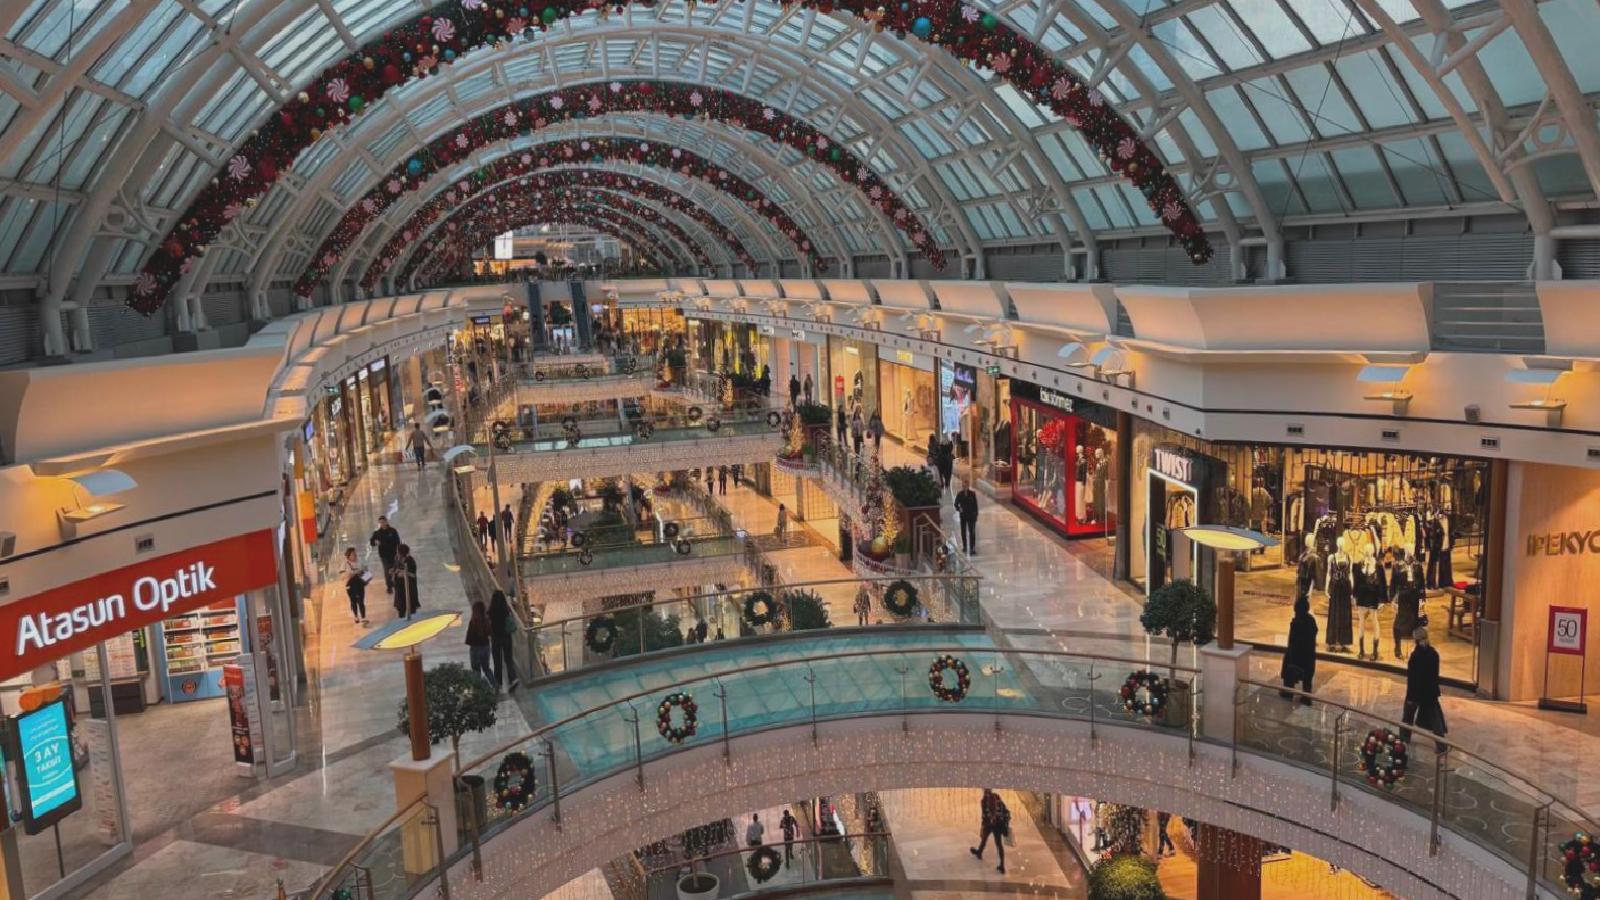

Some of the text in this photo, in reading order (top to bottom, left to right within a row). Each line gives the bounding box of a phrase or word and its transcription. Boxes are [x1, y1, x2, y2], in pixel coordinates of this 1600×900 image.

[1155, 448, 1190, 481] TWIST
[16, 561, 216, 656] Atasun Optik
[1557, 618, 1577, 638] 50
[34, 751, 42, 762] 3
